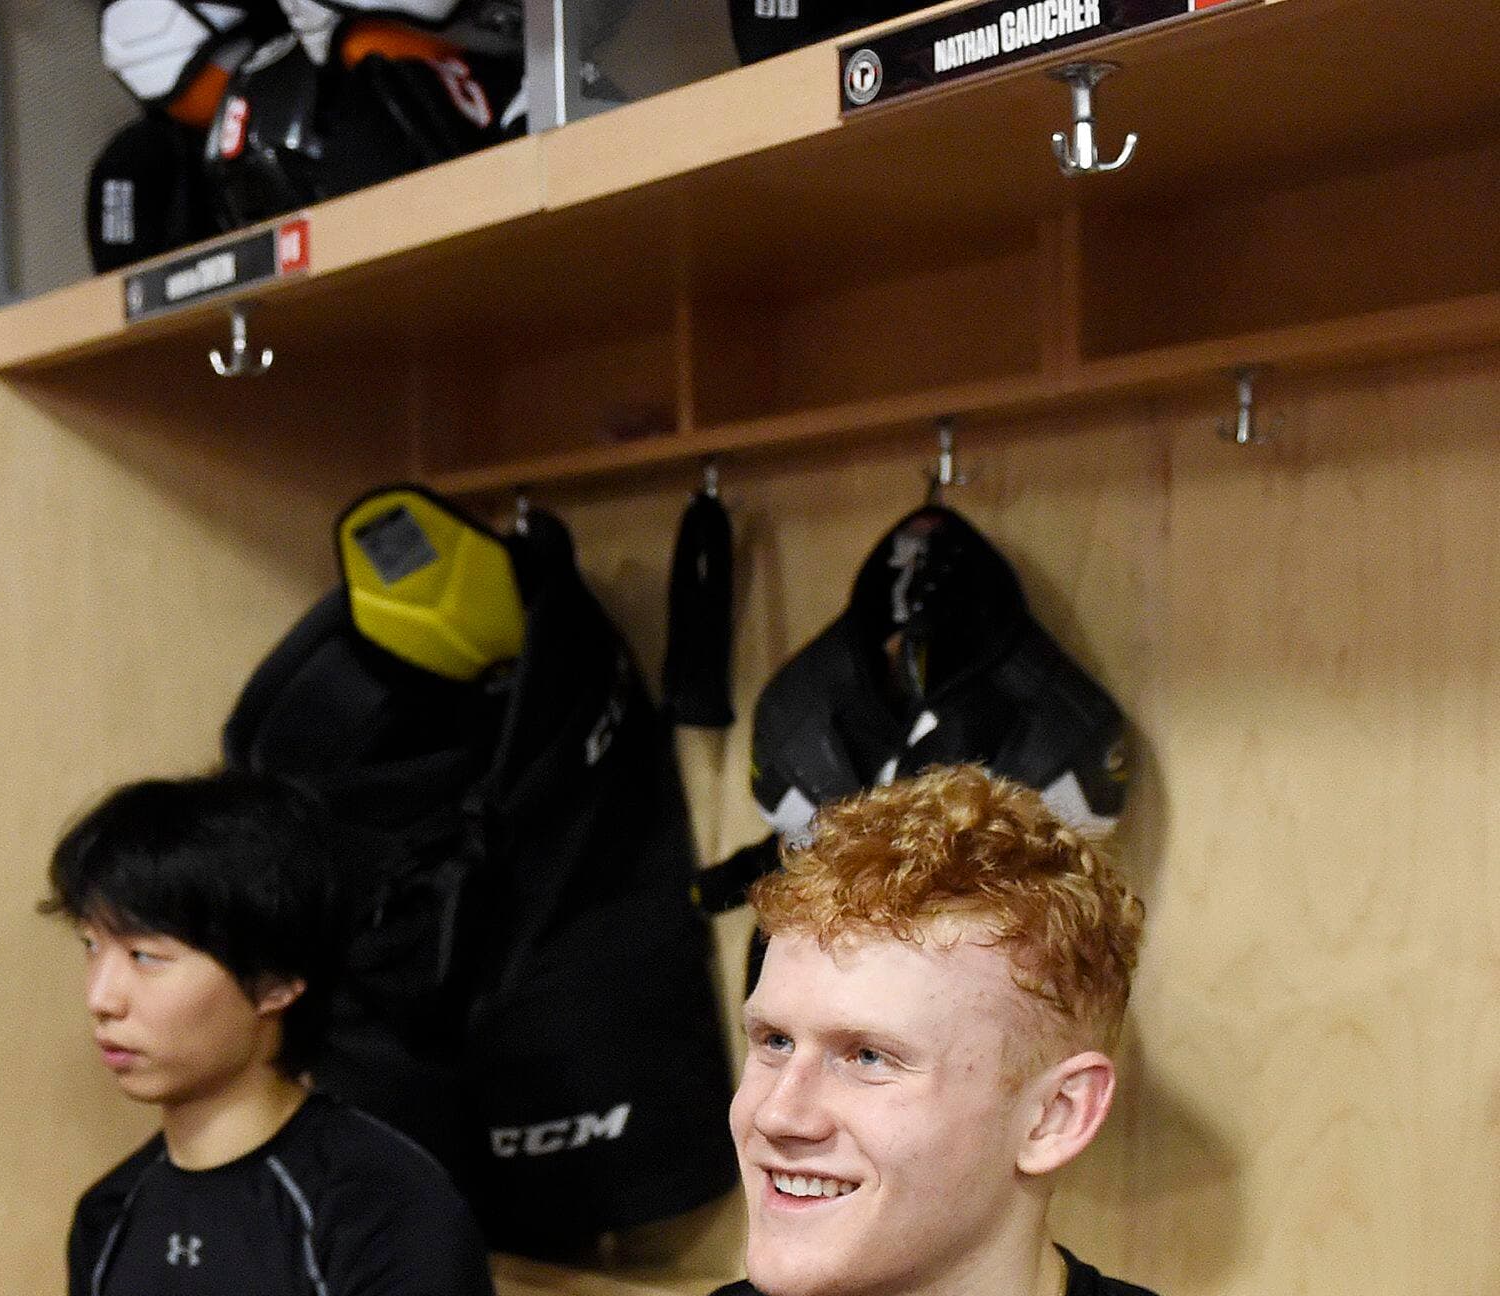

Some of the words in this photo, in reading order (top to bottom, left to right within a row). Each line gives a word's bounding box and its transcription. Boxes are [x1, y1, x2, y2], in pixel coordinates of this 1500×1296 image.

[934, 24, 999, 73] NATHAN
[1000, 0, 1100, 52] GAUCHER
[490, 1103, 631, 1157] CCM
